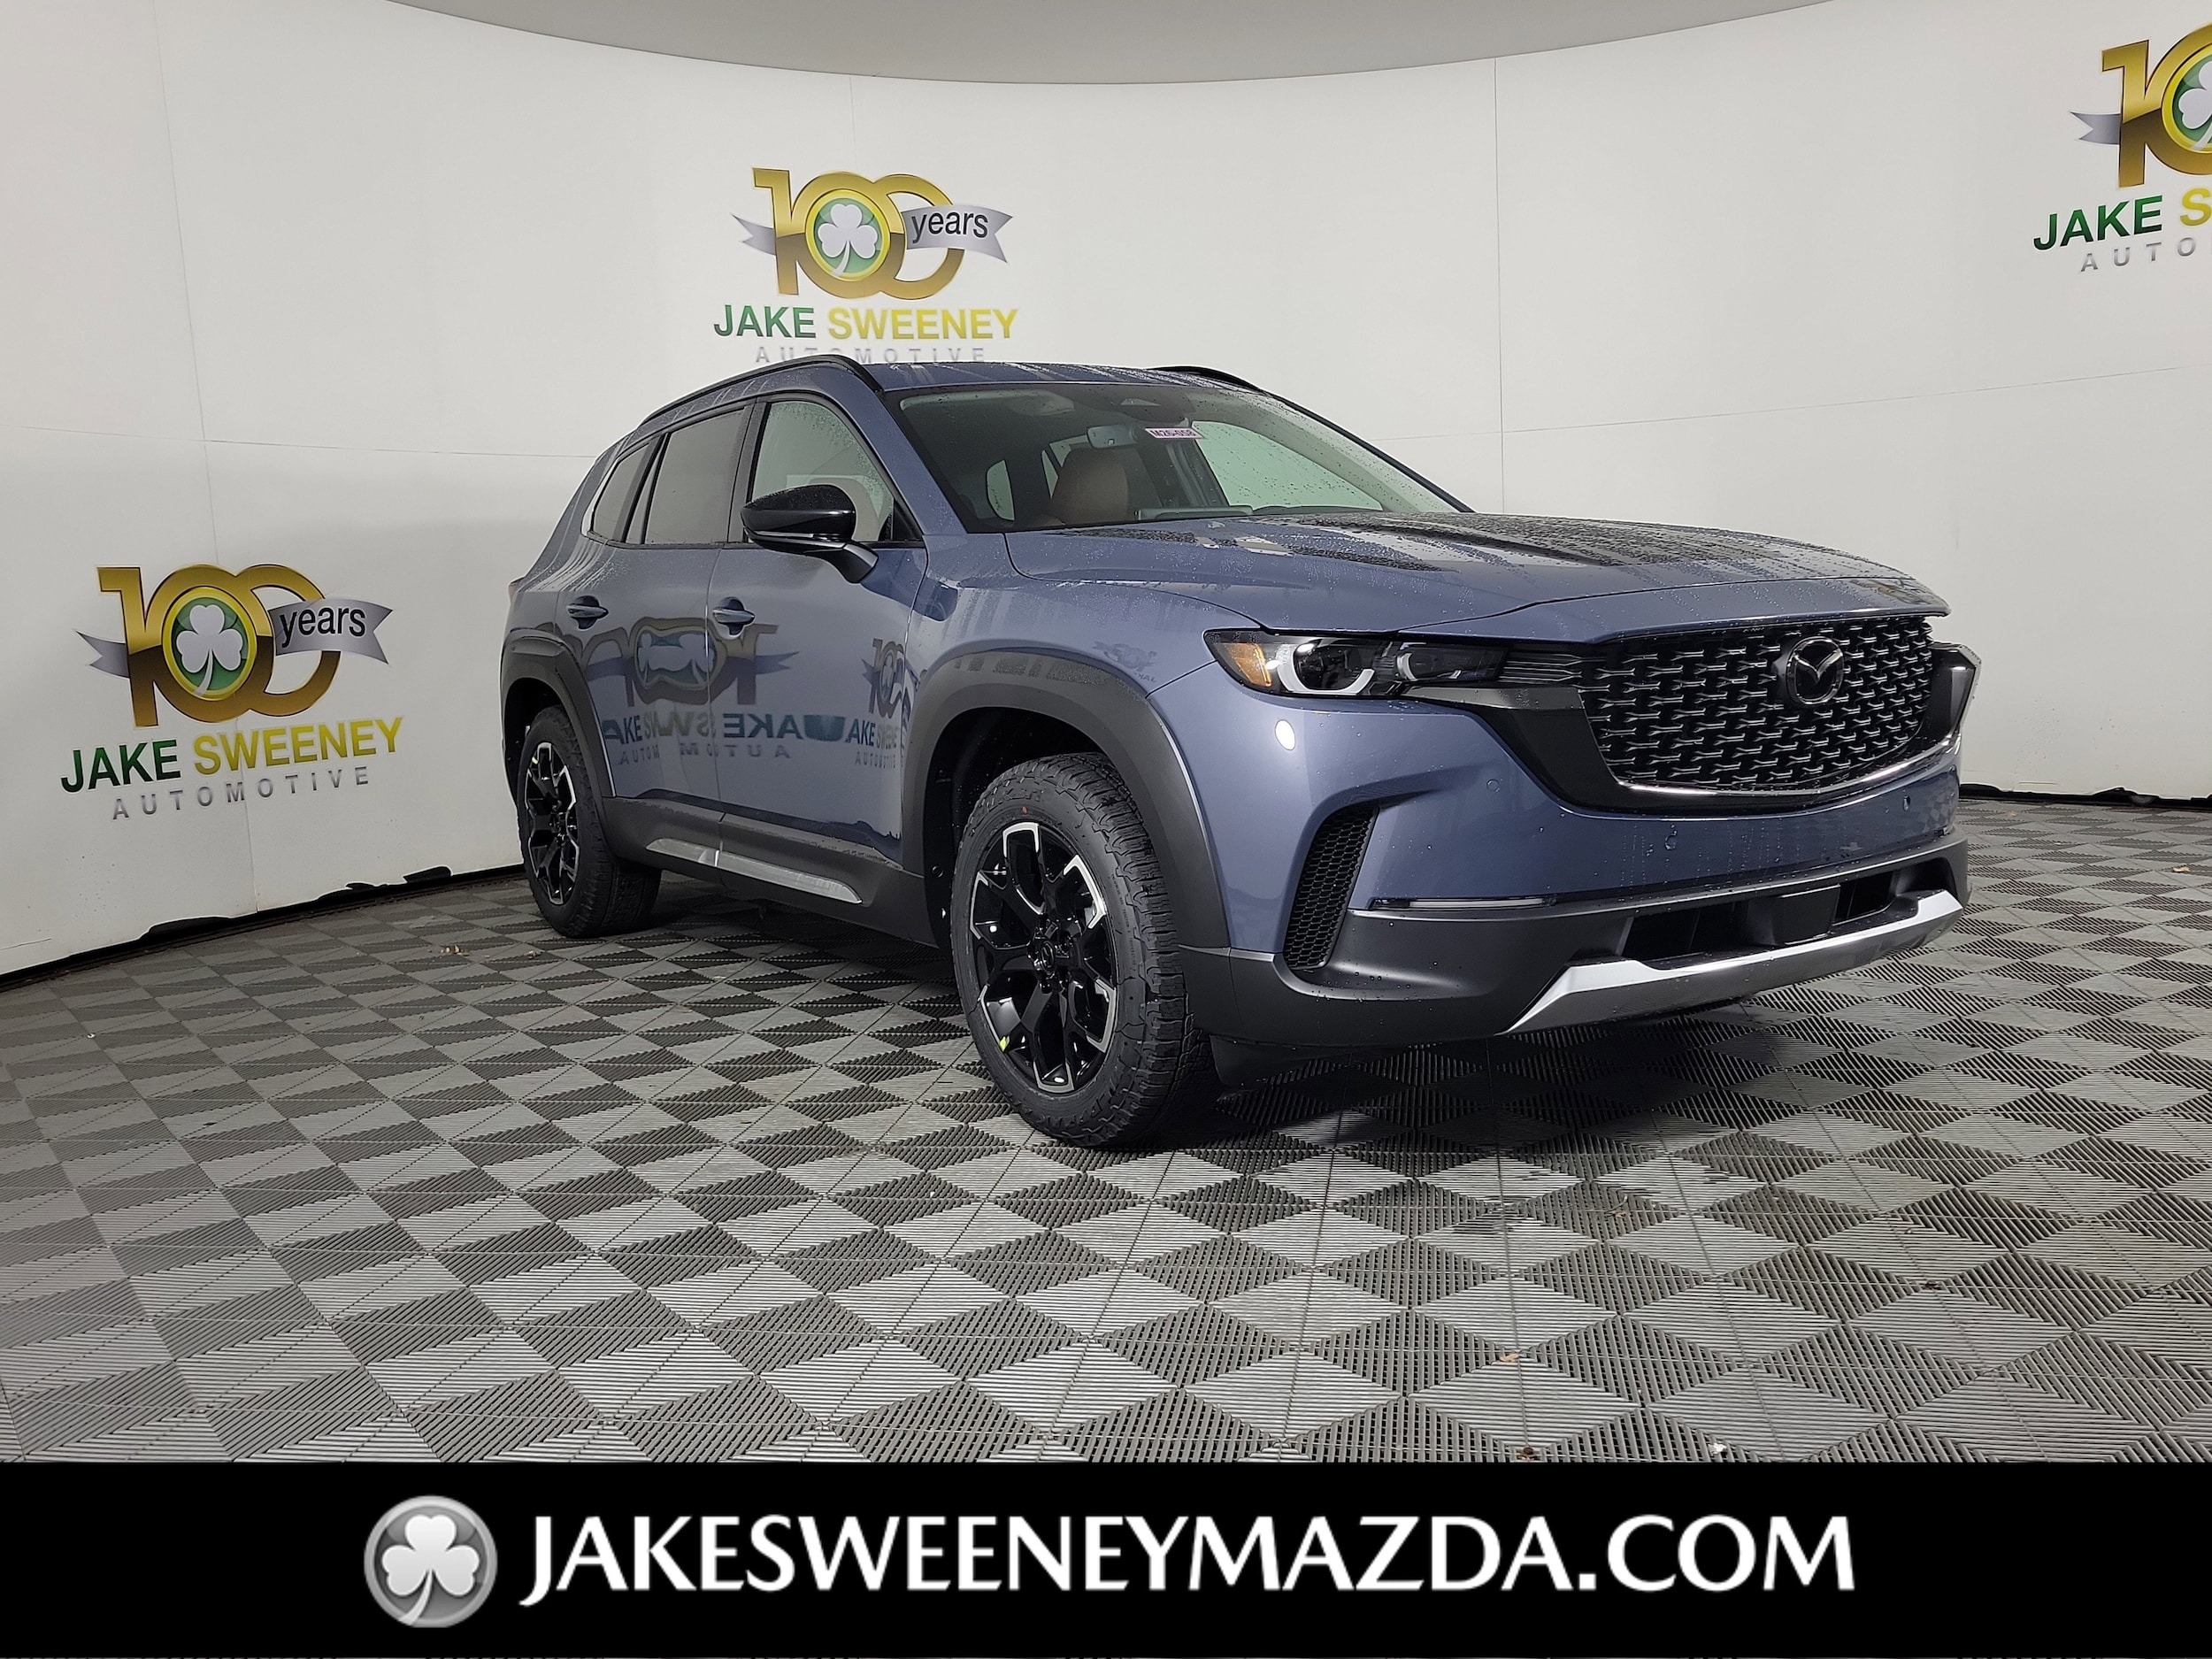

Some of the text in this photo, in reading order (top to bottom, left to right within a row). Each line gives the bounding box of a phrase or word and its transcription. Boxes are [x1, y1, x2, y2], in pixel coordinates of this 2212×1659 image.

[752, 168, 989, 300] 100 years
[2032, 195, 2163, 250] JAKE
[2081, 232, 2212, 273] AUTO
[713, 304, 1019, 341] JAKE SWEENEY
[96, 564, 366, 727] 100 years
[60, 717, 403, 793] JAKE SWEENEY
[112, 765, 370, 820] AUTOMOTIVE
